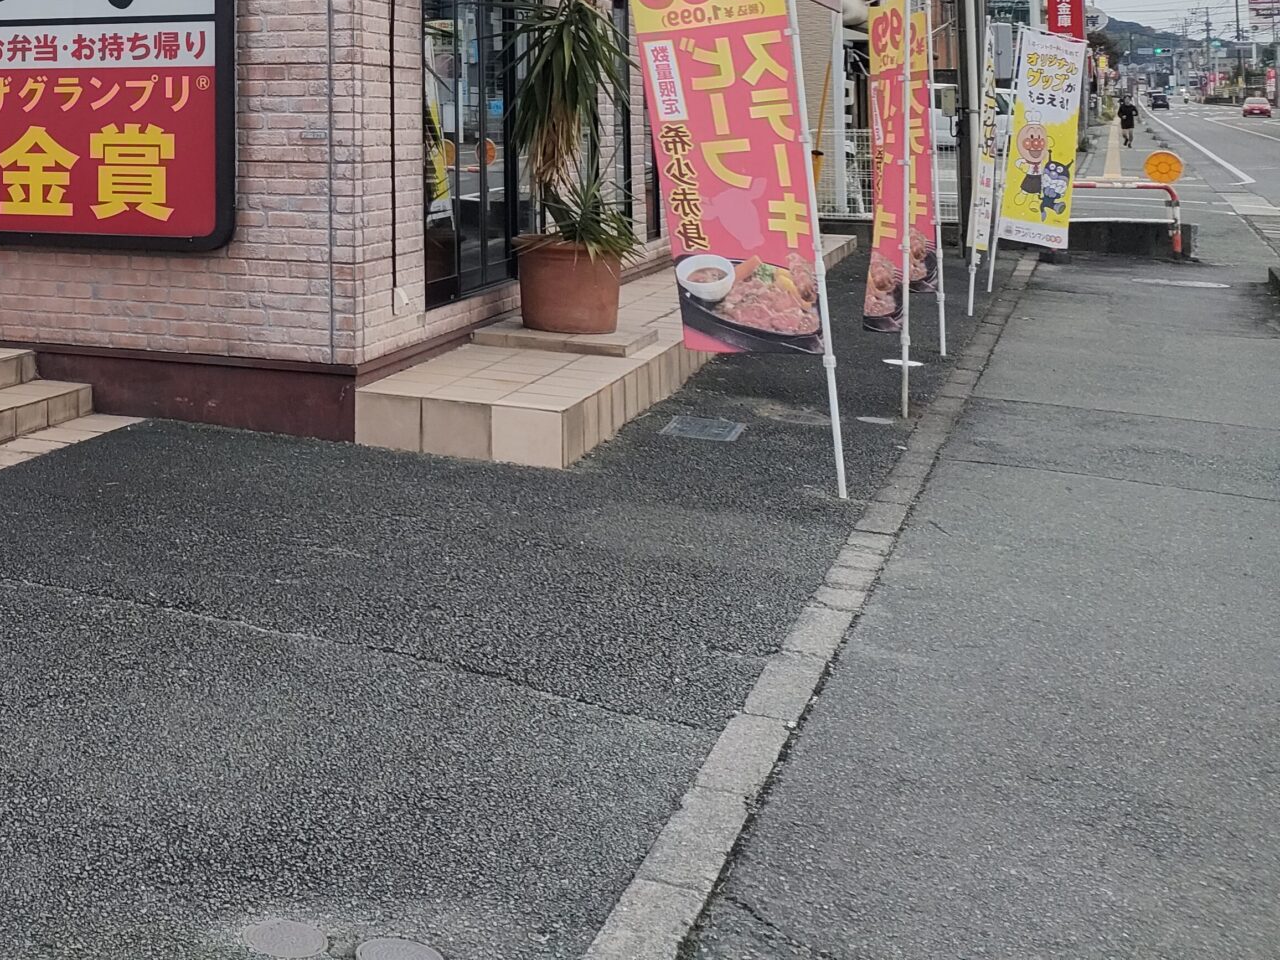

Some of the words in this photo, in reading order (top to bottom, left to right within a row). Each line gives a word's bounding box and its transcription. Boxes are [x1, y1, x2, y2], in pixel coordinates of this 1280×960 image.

[1027, 52, 1078, 75] オリジナル
